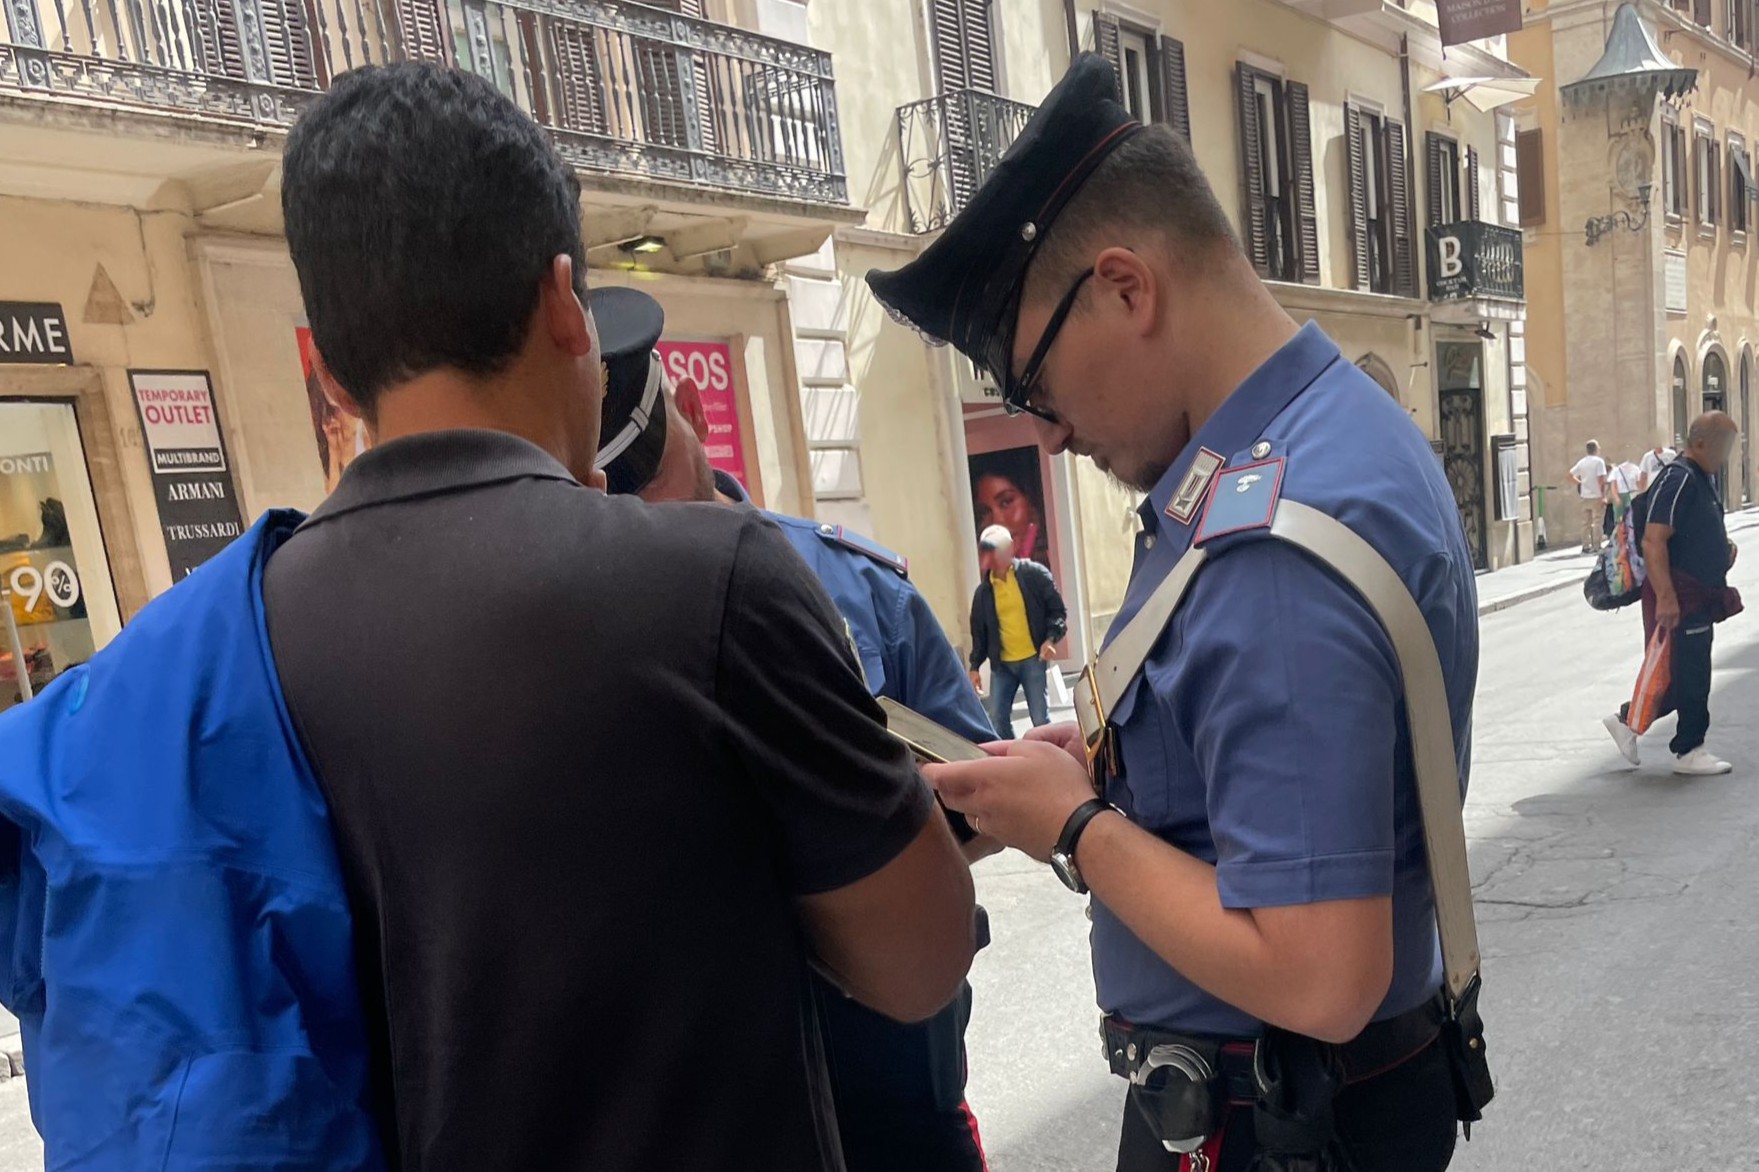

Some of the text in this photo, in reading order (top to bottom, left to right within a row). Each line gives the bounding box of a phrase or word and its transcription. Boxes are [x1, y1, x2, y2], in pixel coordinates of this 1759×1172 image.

[1439, 236, 1463, 278] B
[138, 389, 208, 402] TEMPORARY
[145, 405, 211, 424] OUTLET
[157, 452, 220, 464] MULTIBRAND
[168, 482, 225, 501] ARMANI
[167, 522, 240, 541] TRUSSARDI
